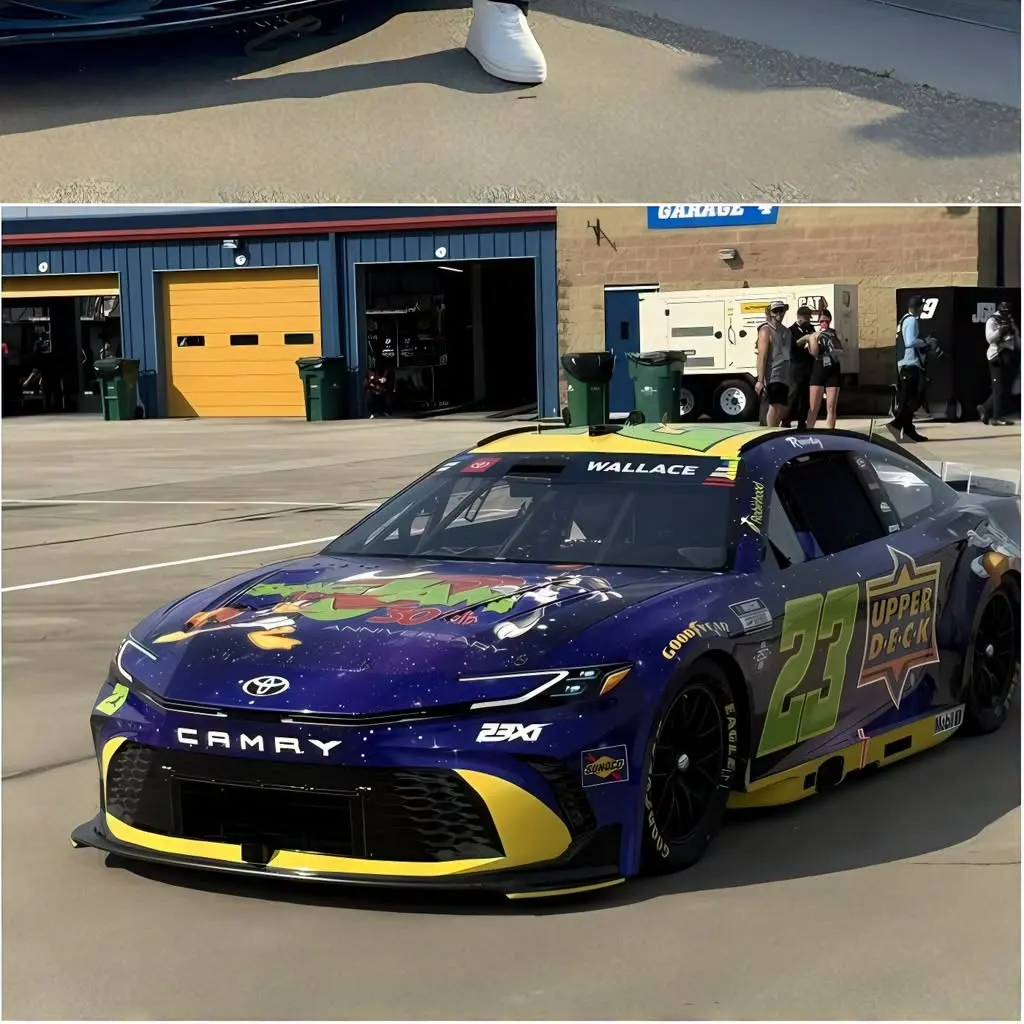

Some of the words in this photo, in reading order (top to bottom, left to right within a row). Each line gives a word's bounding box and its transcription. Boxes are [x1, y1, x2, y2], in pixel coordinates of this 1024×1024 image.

[587, 461, 699, 476] WALLACE
[871, 587, 932, 628] UPPER
[662, 621, 730, 659] GOODYEAR
[756, 583, 860, 758] 23
[177, 727, 342, 757] CAMRY
[584, 759, 625, 775] SUNOCO
